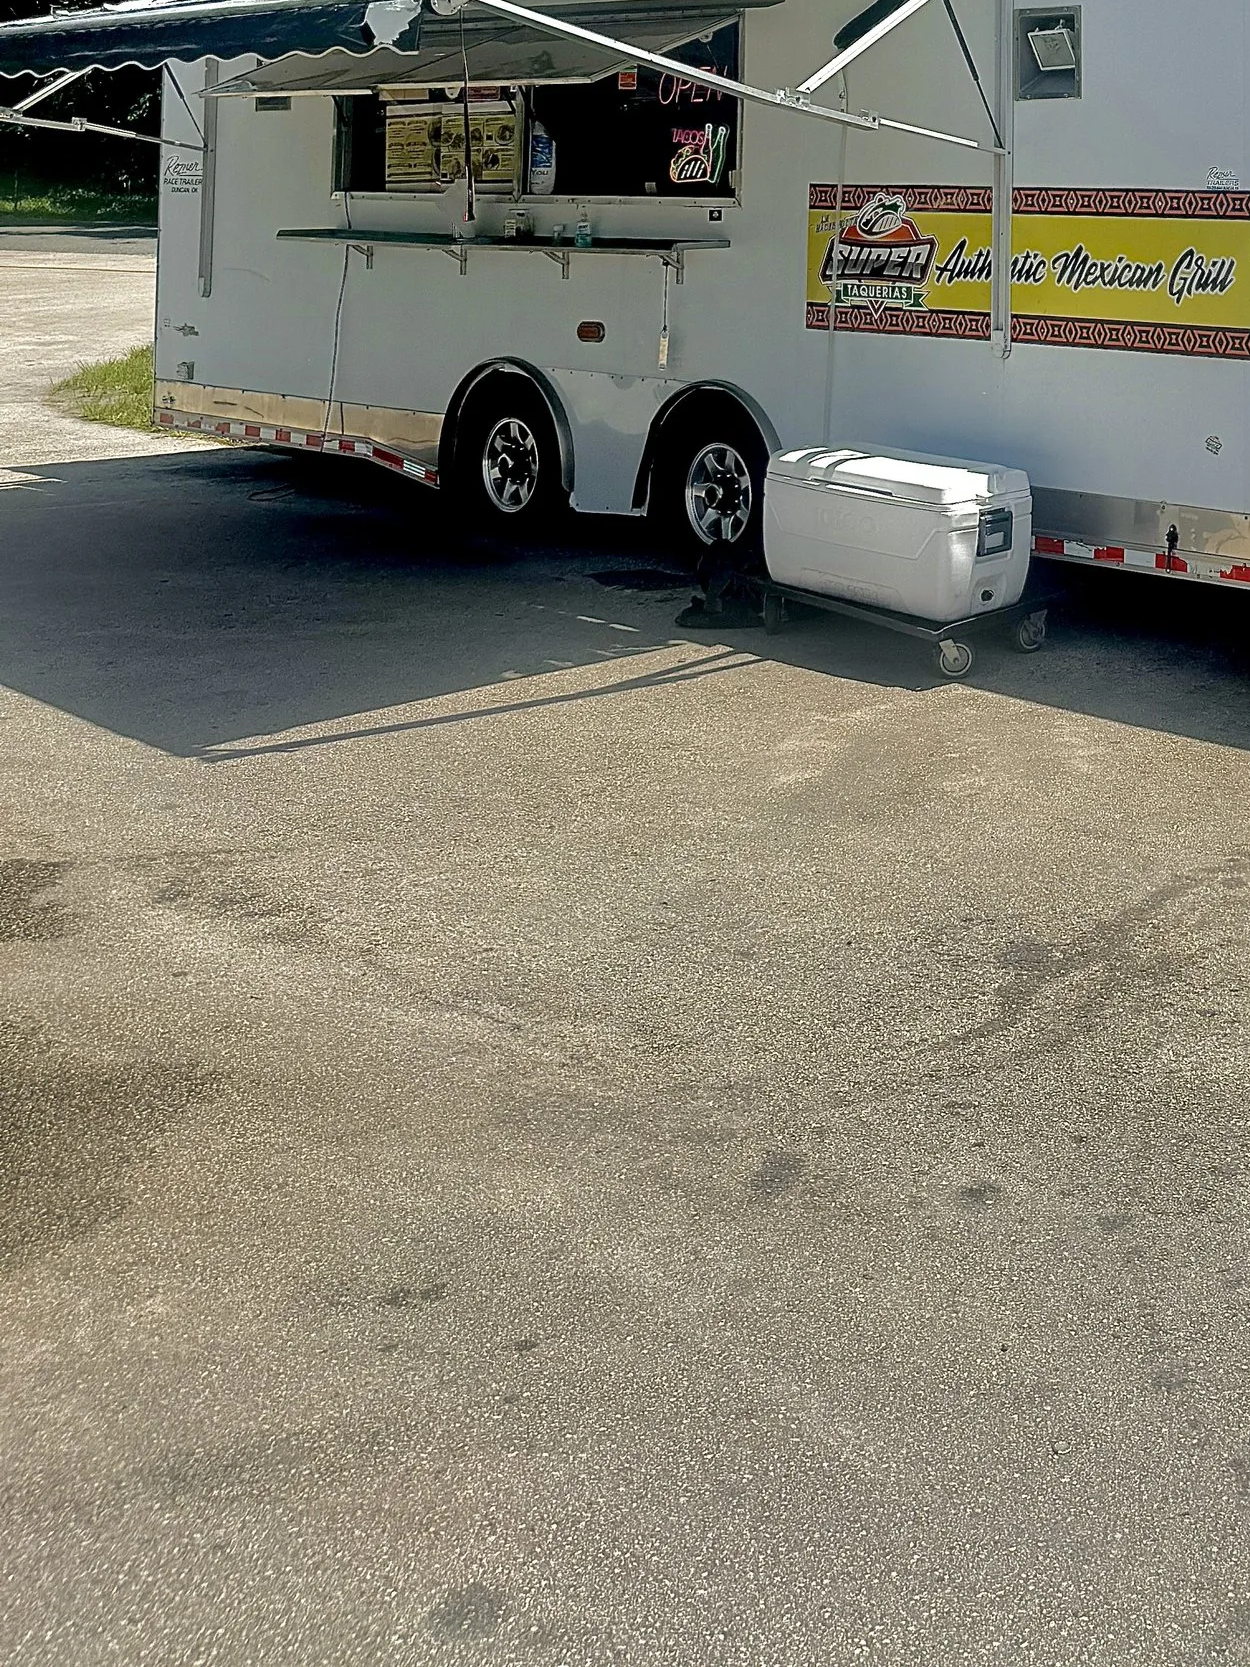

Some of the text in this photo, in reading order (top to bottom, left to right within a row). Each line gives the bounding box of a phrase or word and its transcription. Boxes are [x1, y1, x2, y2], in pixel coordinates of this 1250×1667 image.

[671, 128, 705, 145] TACOS
[826, 243, 931, 279] SUPER
[935, 238, 1235, 305] Authntic Mexican Grill
[847, 284, 908, 300] TAQUERIAS
